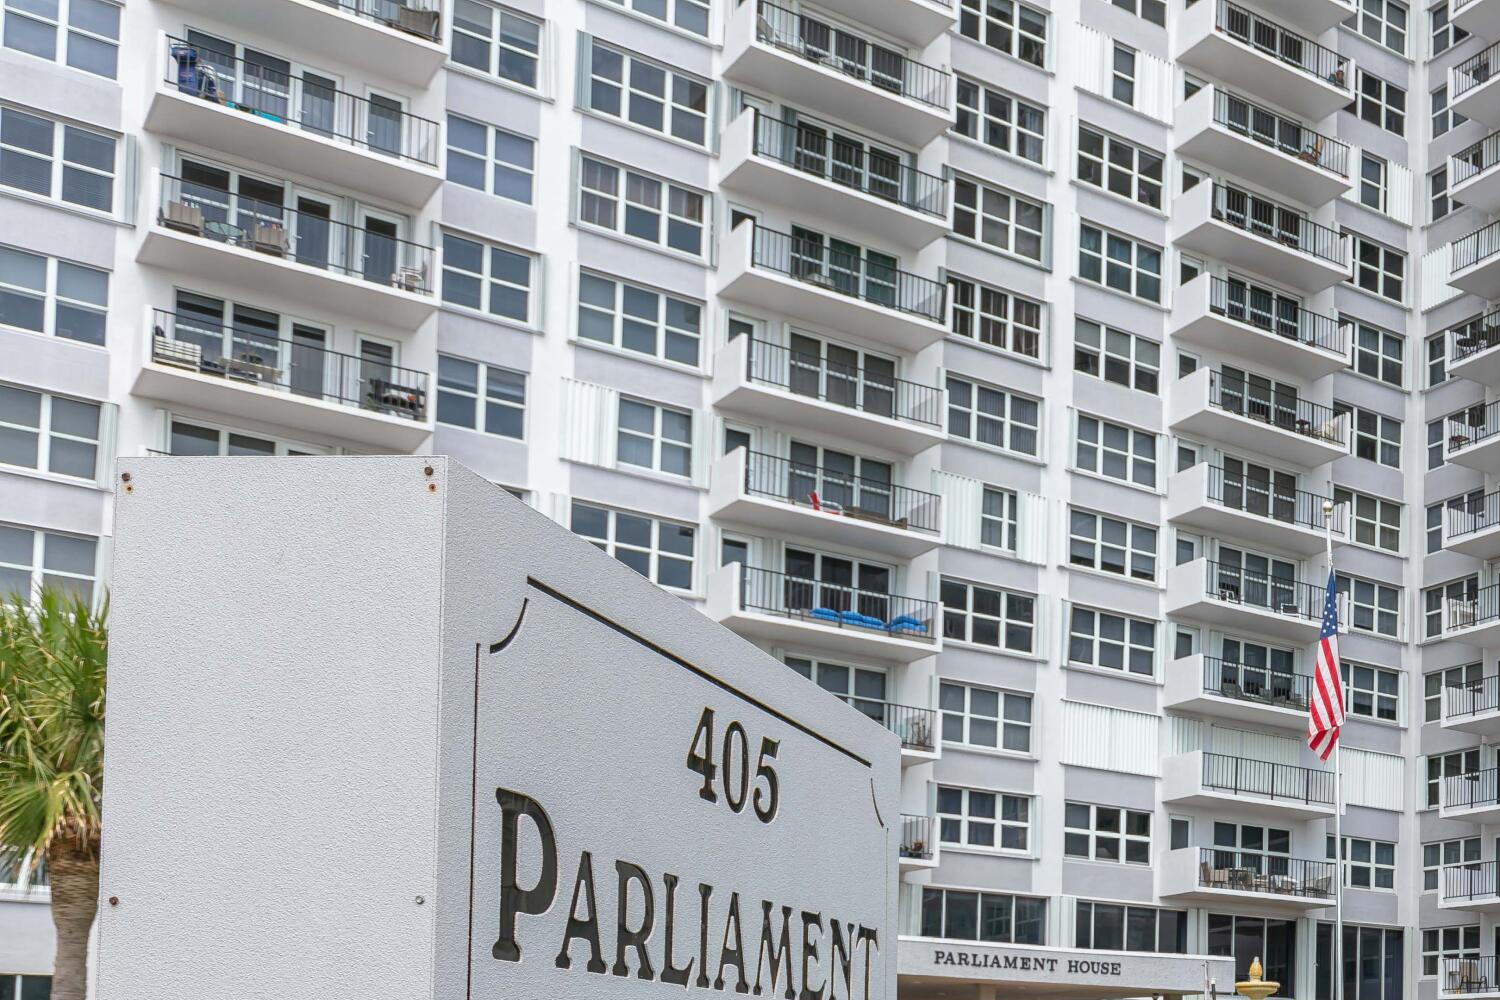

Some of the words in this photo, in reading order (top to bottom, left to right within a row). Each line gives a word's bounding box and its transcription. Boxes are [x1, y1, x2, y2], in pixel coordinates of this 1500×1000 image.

[687, 707, 780, 824] 405
[934, 951, 1058, 972] PARLIAMENT
[1067, 960, 1122, 975] HOUSE
